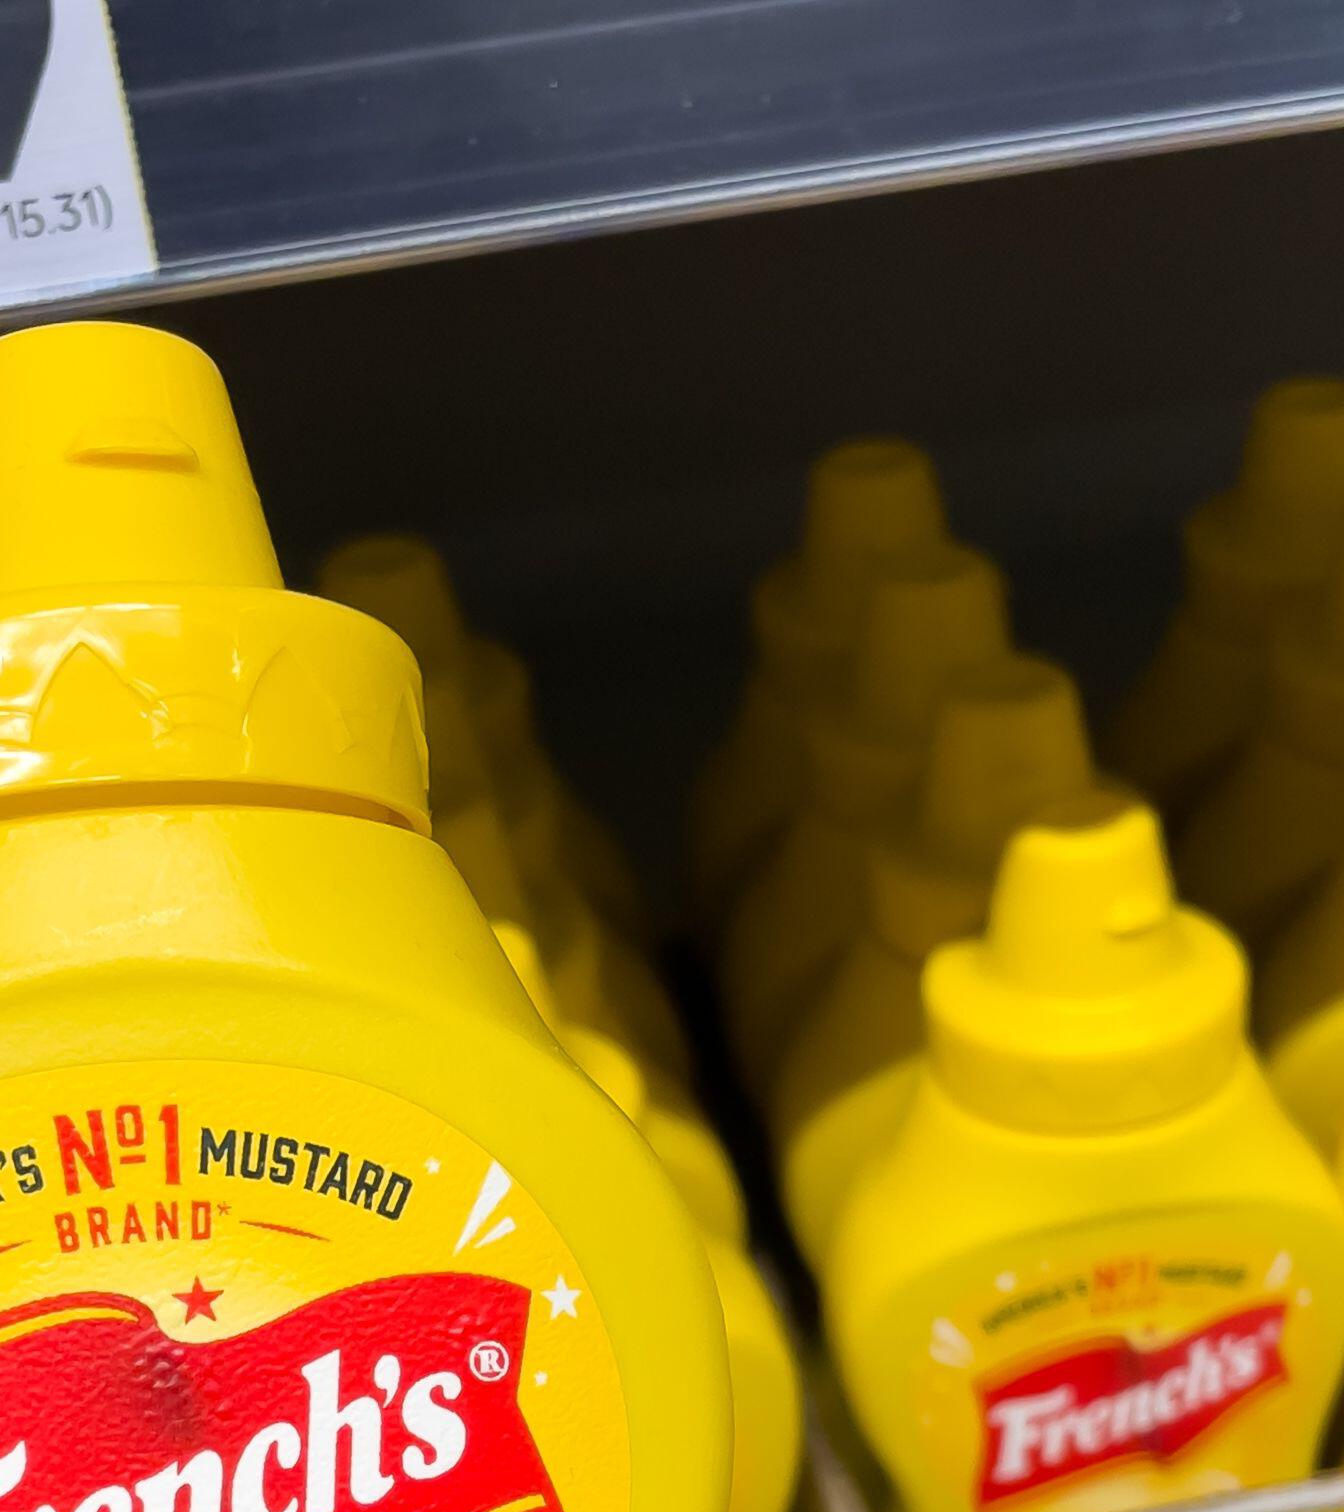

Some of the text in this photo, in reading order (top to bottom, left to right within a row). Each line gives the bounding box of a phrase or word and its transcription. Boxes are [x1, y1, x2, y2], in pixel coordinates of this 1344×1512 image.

[0, 183, 116, 243] 15.31)
[198, 1126, 413, 1222] MUSTARD
[987, 1335, 1264, 1484] French's
